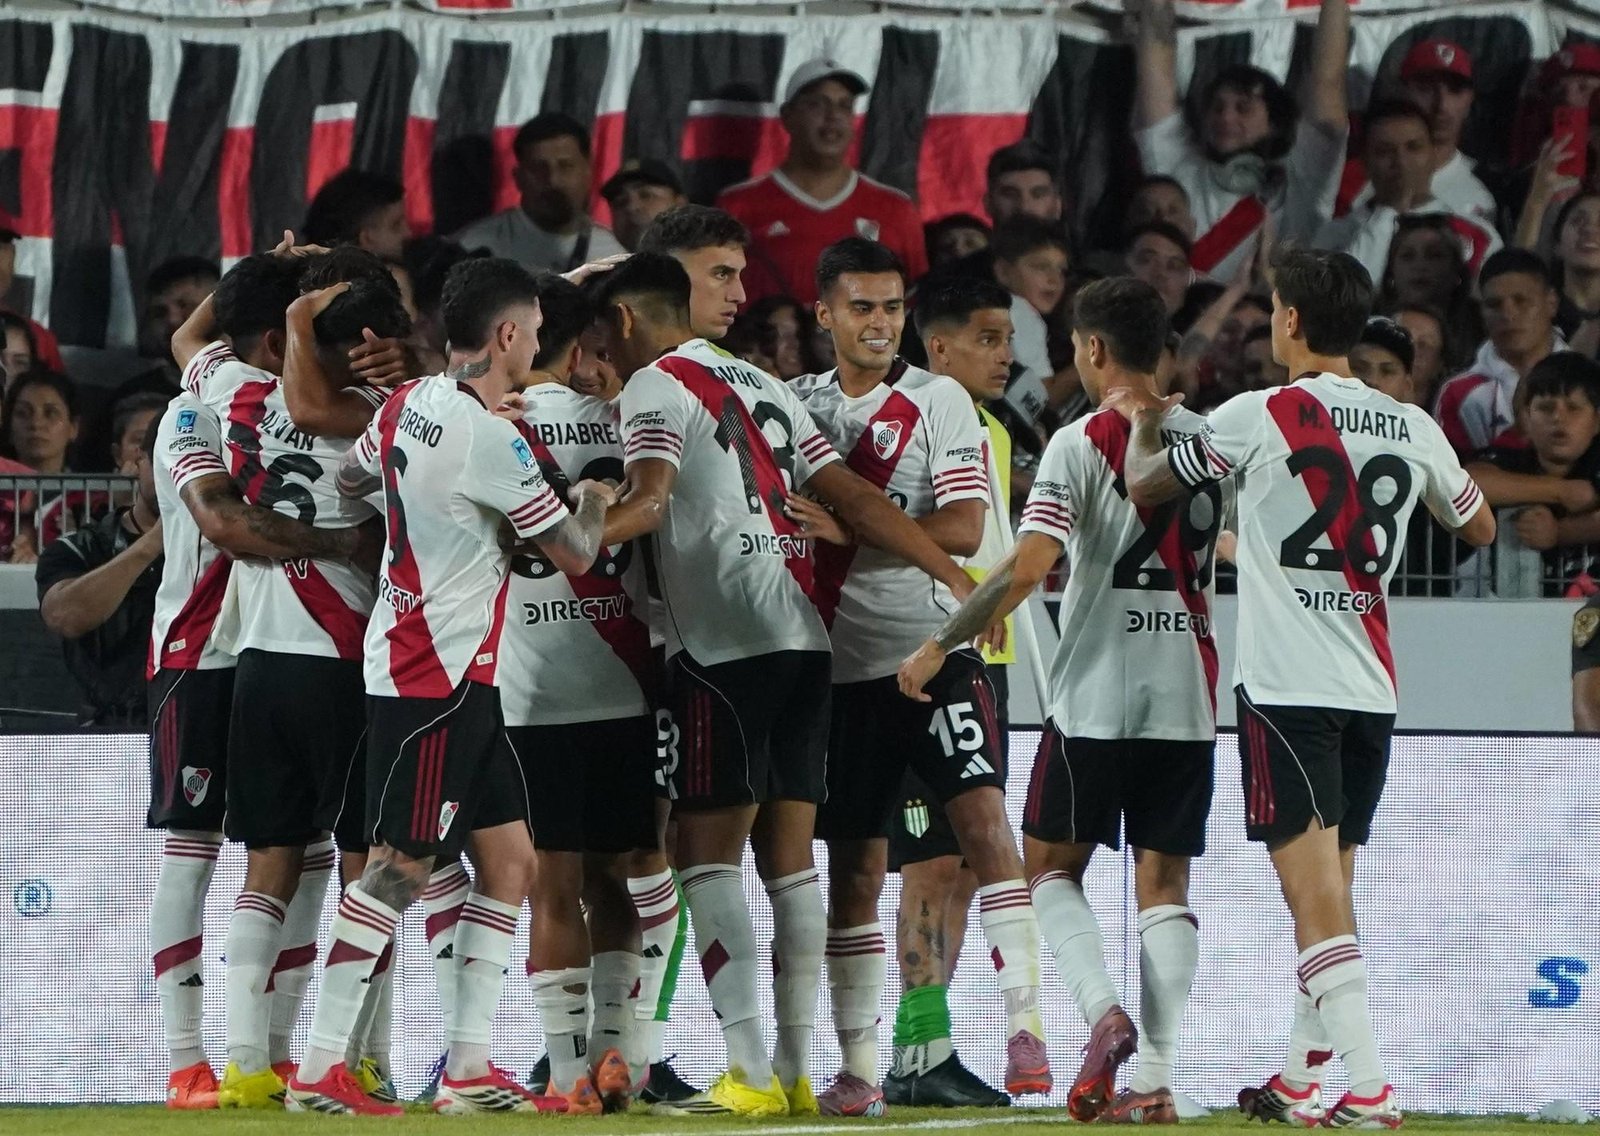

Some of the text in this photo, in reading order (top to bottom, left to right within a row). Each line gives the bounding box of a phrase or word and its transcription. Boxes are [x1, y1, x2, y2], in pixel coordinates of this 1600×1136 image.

[1331, 406, 1411, 444] QUARTA
[1280, 445, 1412, 576] 28
[522, 594, 627, 626] DIRECTV
[928, 701, 984, 758] 15
